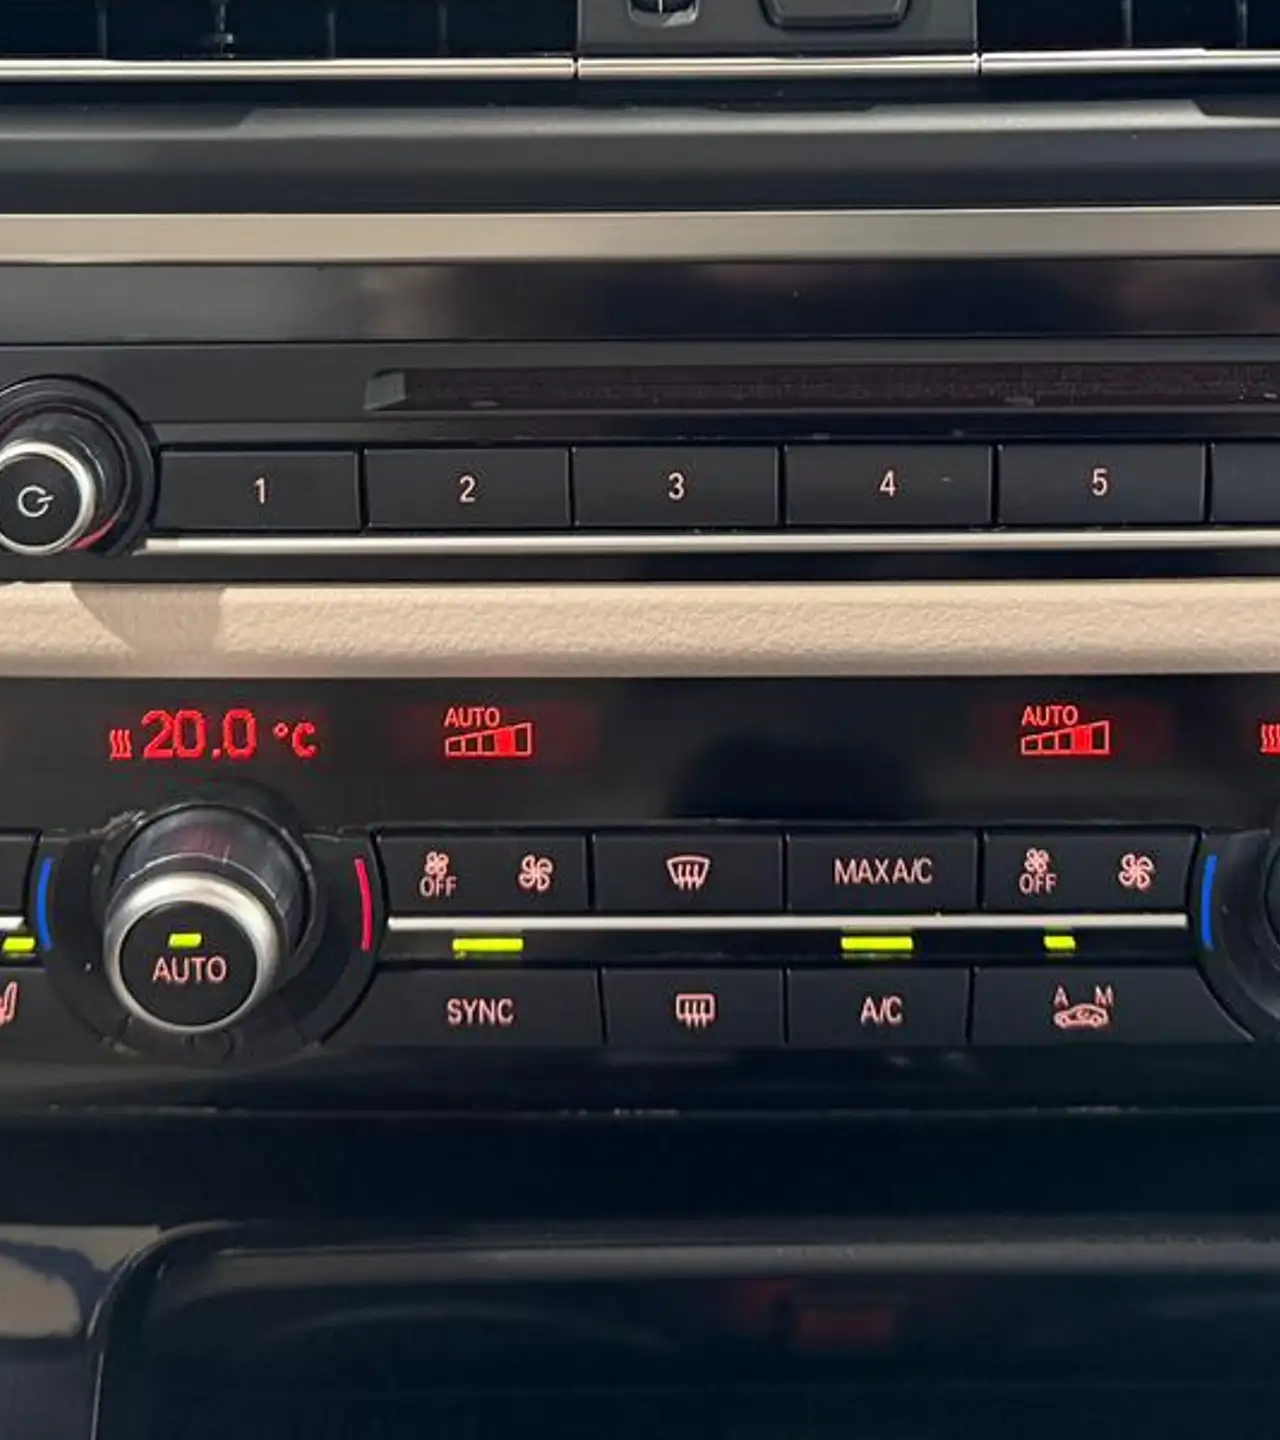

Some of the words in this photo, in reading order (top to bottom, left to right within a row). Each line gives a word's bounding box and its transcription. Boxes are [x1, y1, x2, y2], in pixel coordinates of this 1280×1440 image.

[253, 478, 268, 506] 1
[458, 475, 477, 504] 2
[668, 472, 686, 500] 3
[878, 470, 898, 499] 4
[1090, 467, 1109, 497] 5
[443, 706, 501, 728] AUTO
[1021, 704, 1079, 727] AUTO
[141, 708, 258, 759] 20.0
[833, 858, 889, 885] MAX
[892, 857, 933, 885] A/C
[1018, 873, 1058, 896] OFF
[419, 876, 458, 898] OFF
[151, 955, 228, 985] AUTO
[446, 997, 515, 1027] SYNC
[859, 995, 904, 1025] A/C
